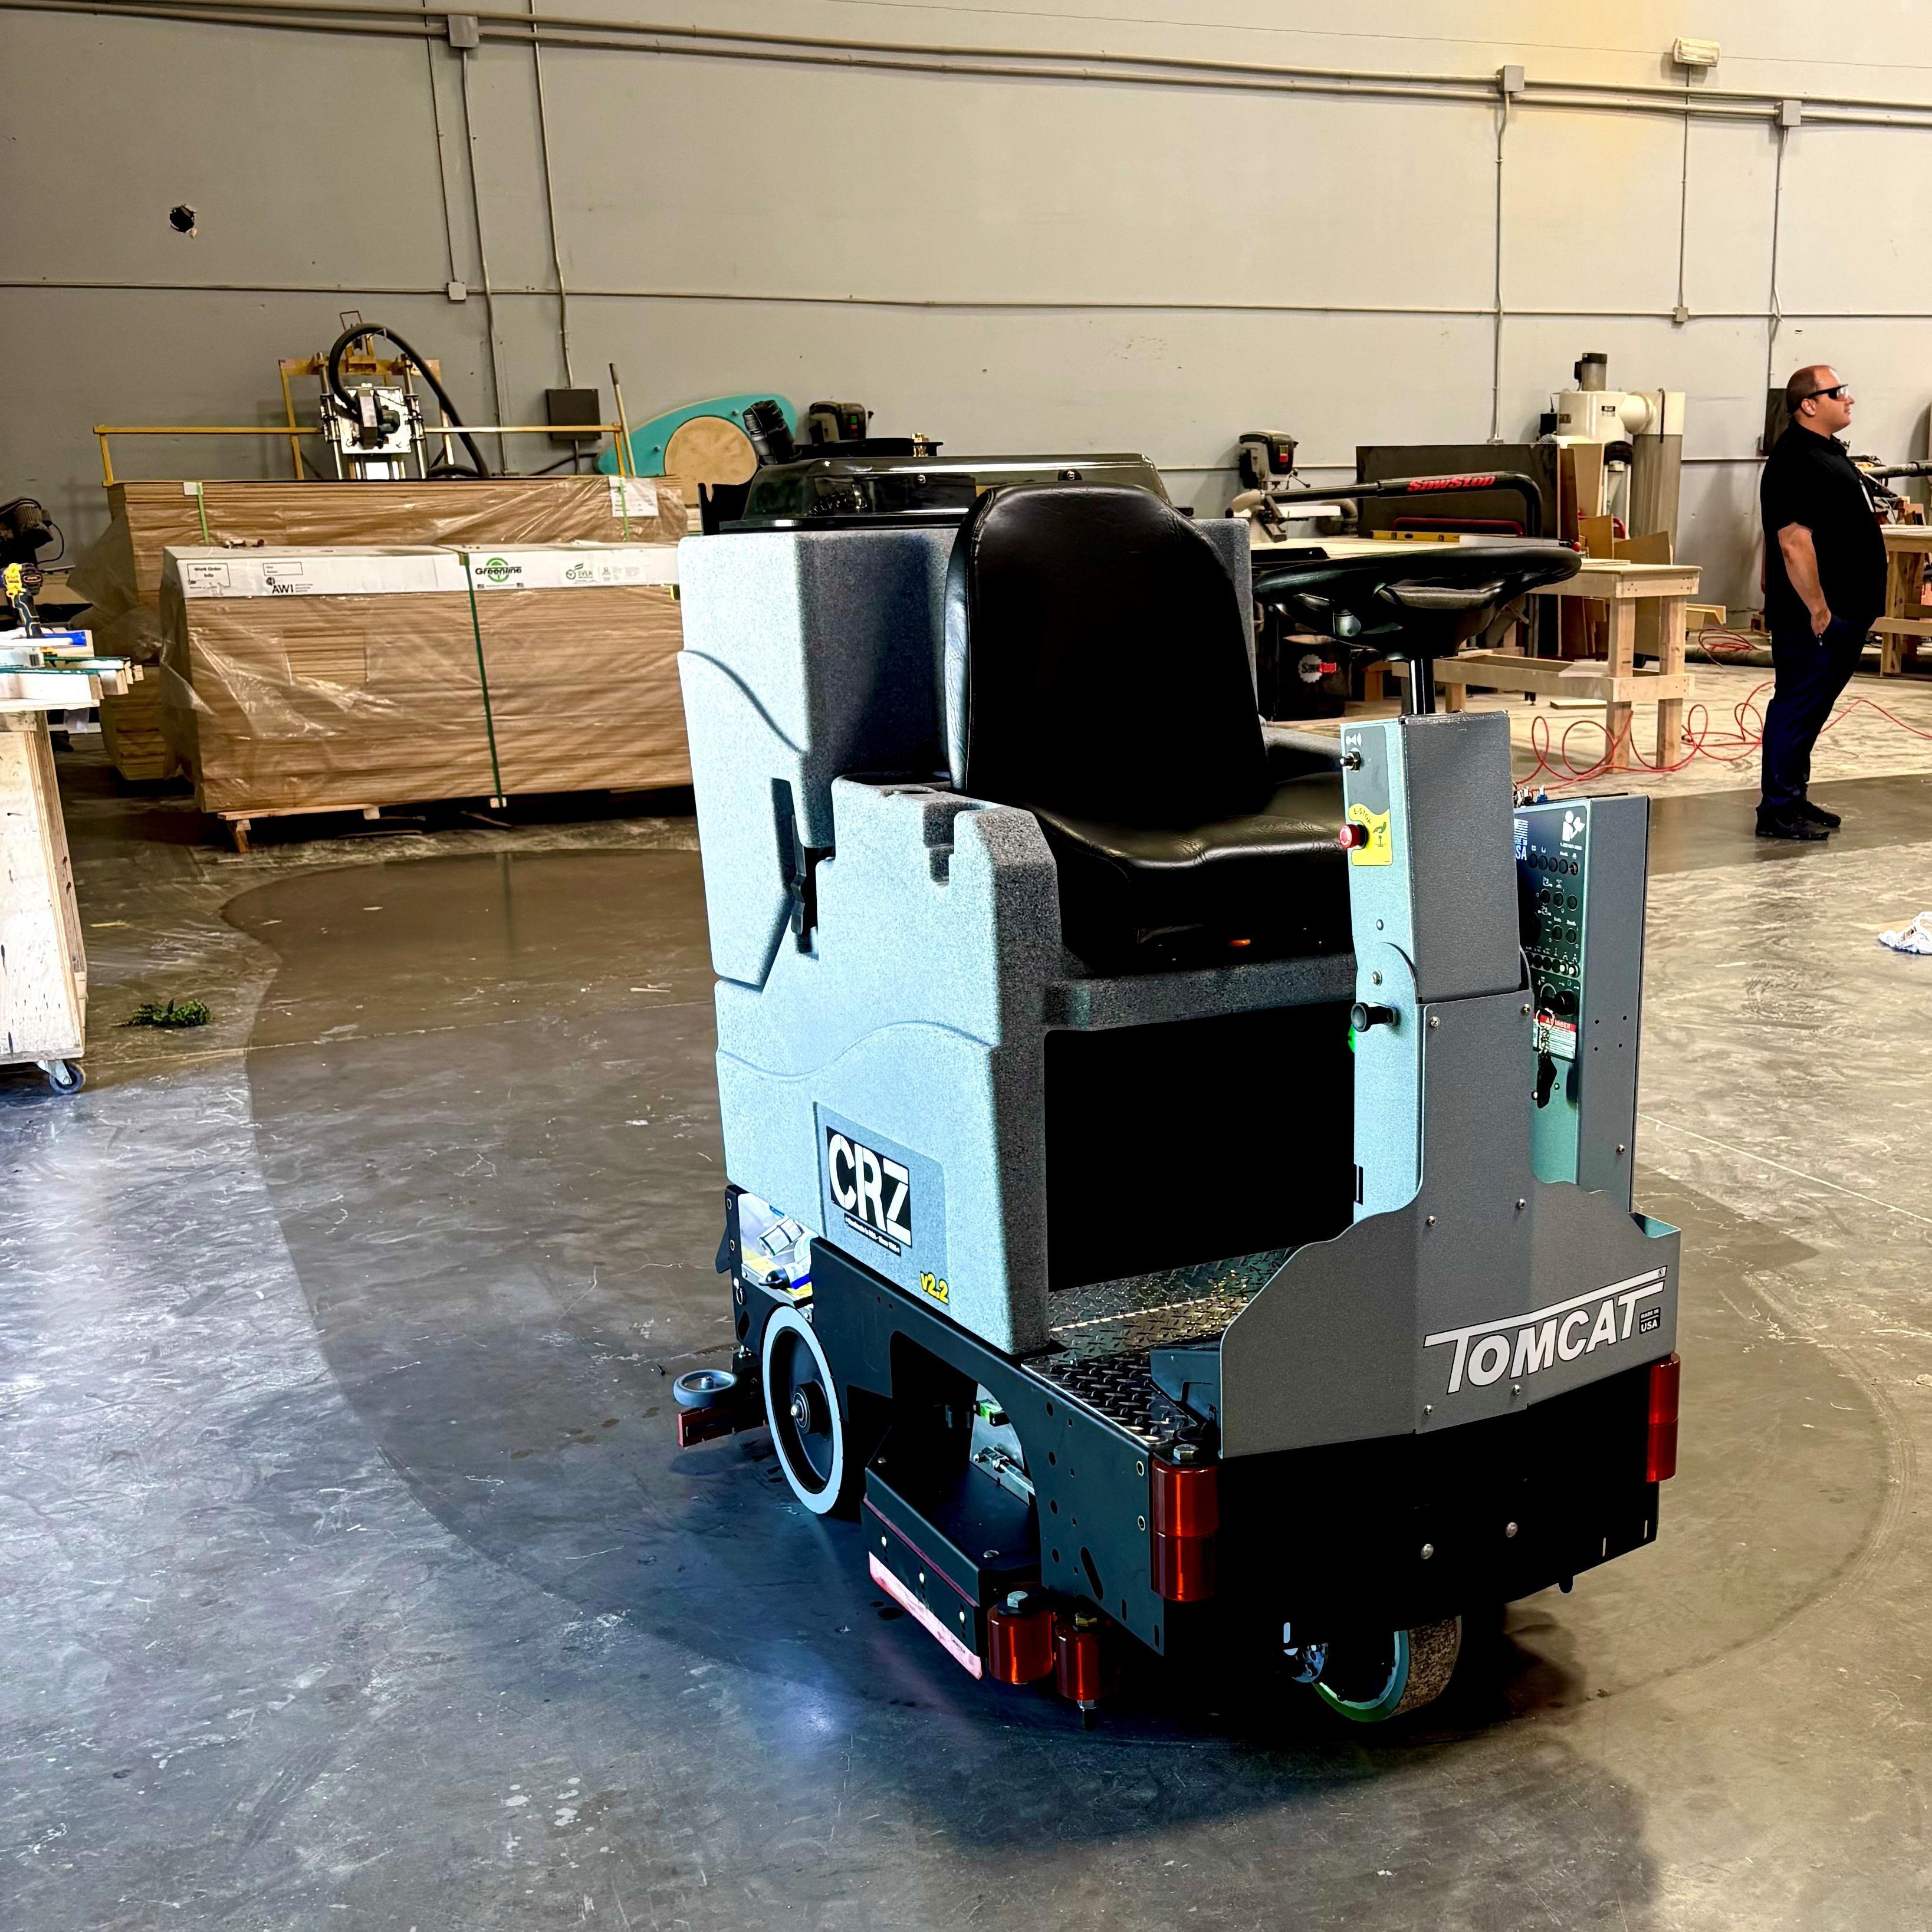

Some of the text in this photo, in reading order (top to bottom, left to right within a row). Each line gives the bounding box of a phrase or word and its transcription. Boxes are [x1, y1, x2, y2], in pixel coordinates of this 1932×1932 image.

[1407, 476, 1496, 492] SawStop
[475, 566, 522, 575] Greenline
[272, 584, 294, 594] AWI
[1516, 845, 1527, 861] SA
[829, 1133, 912, 1246] CRZ
[1423, 1265, 1668, 1395] TOMCAT
[1641, 1319, 1658, 1332] USA
